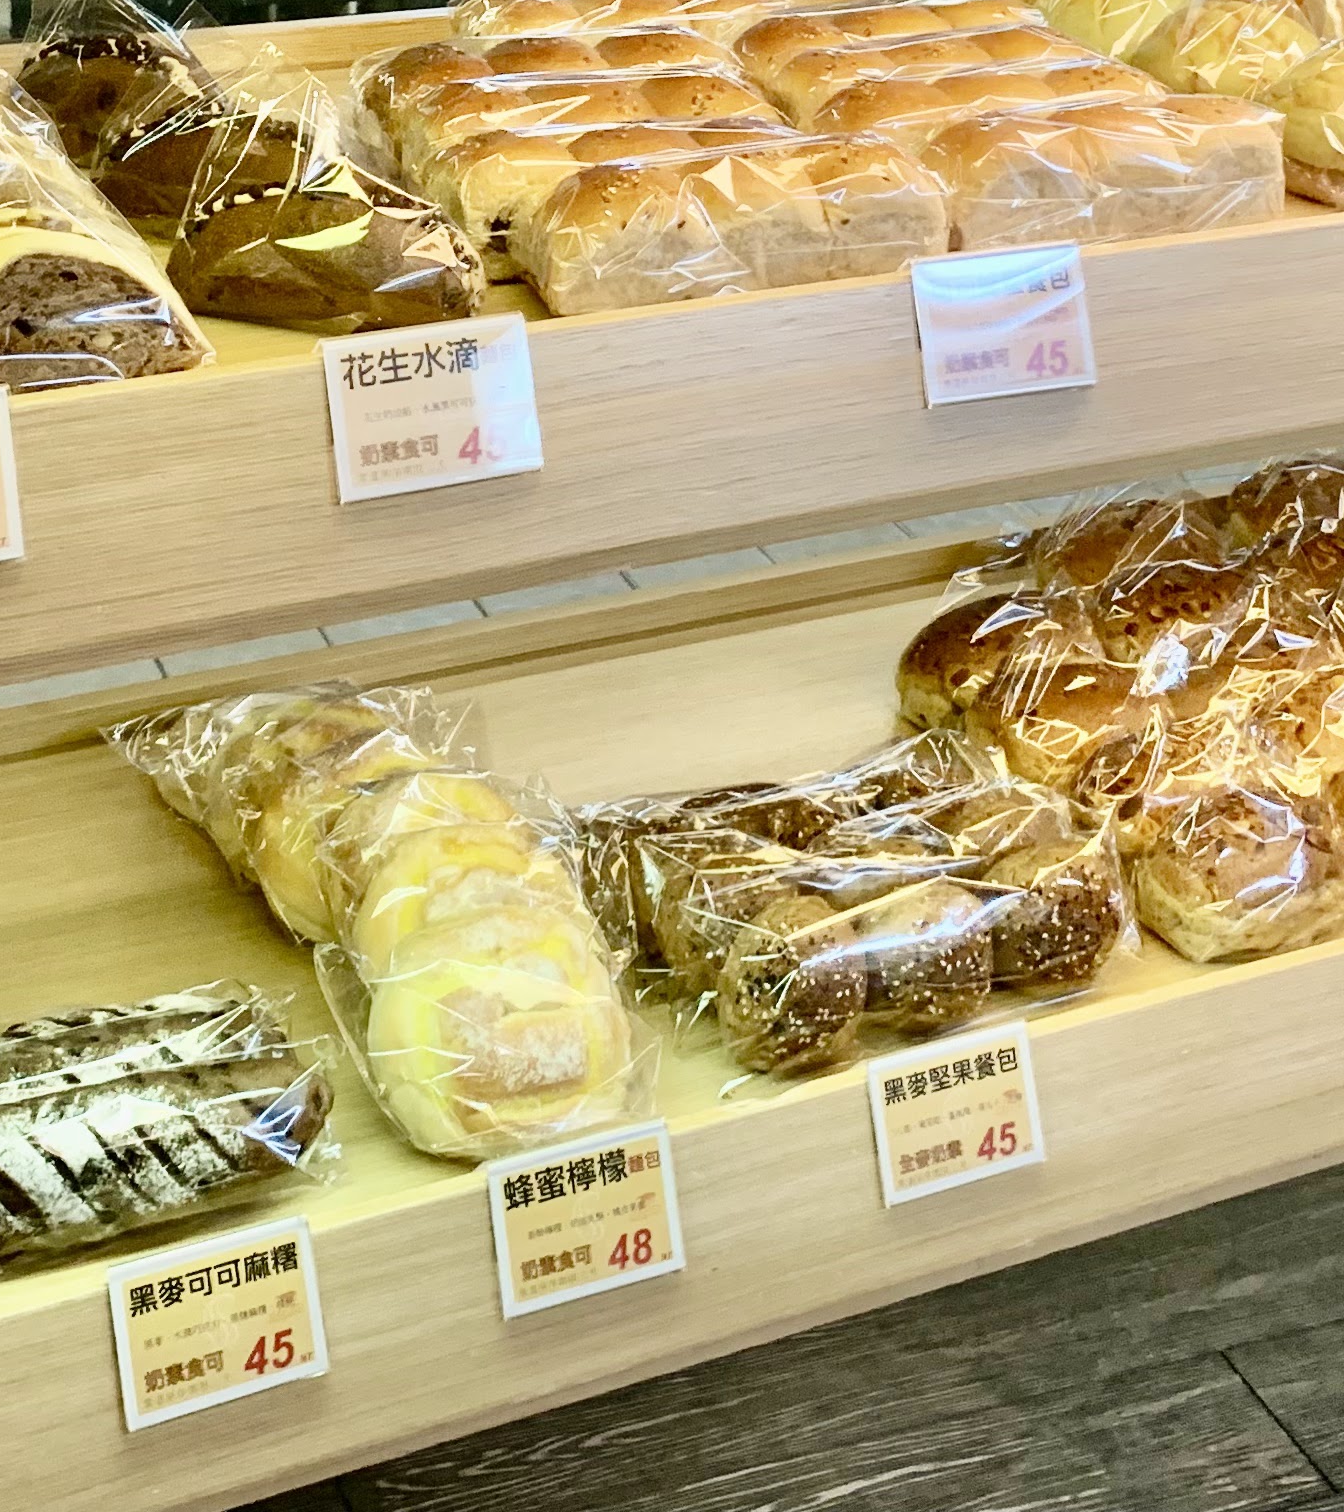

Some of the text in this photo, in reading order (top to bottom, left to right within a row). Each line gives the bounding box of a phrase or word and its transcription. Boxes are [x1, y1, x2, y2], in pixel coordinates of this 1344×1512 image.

[340, 337, 515, 390] 花生水滴
[1026, 340, 1069, 377] 45
[884, 1047, 1018, 1105] 黑麥堅果餐包
[977, 1121, 1017, 1160] 45
[608, 1228, 652, 1270] 48
[130, 1242, 298, 1317] 黑麥可可麻糬
[244, 1328, 294, 1375] 45
